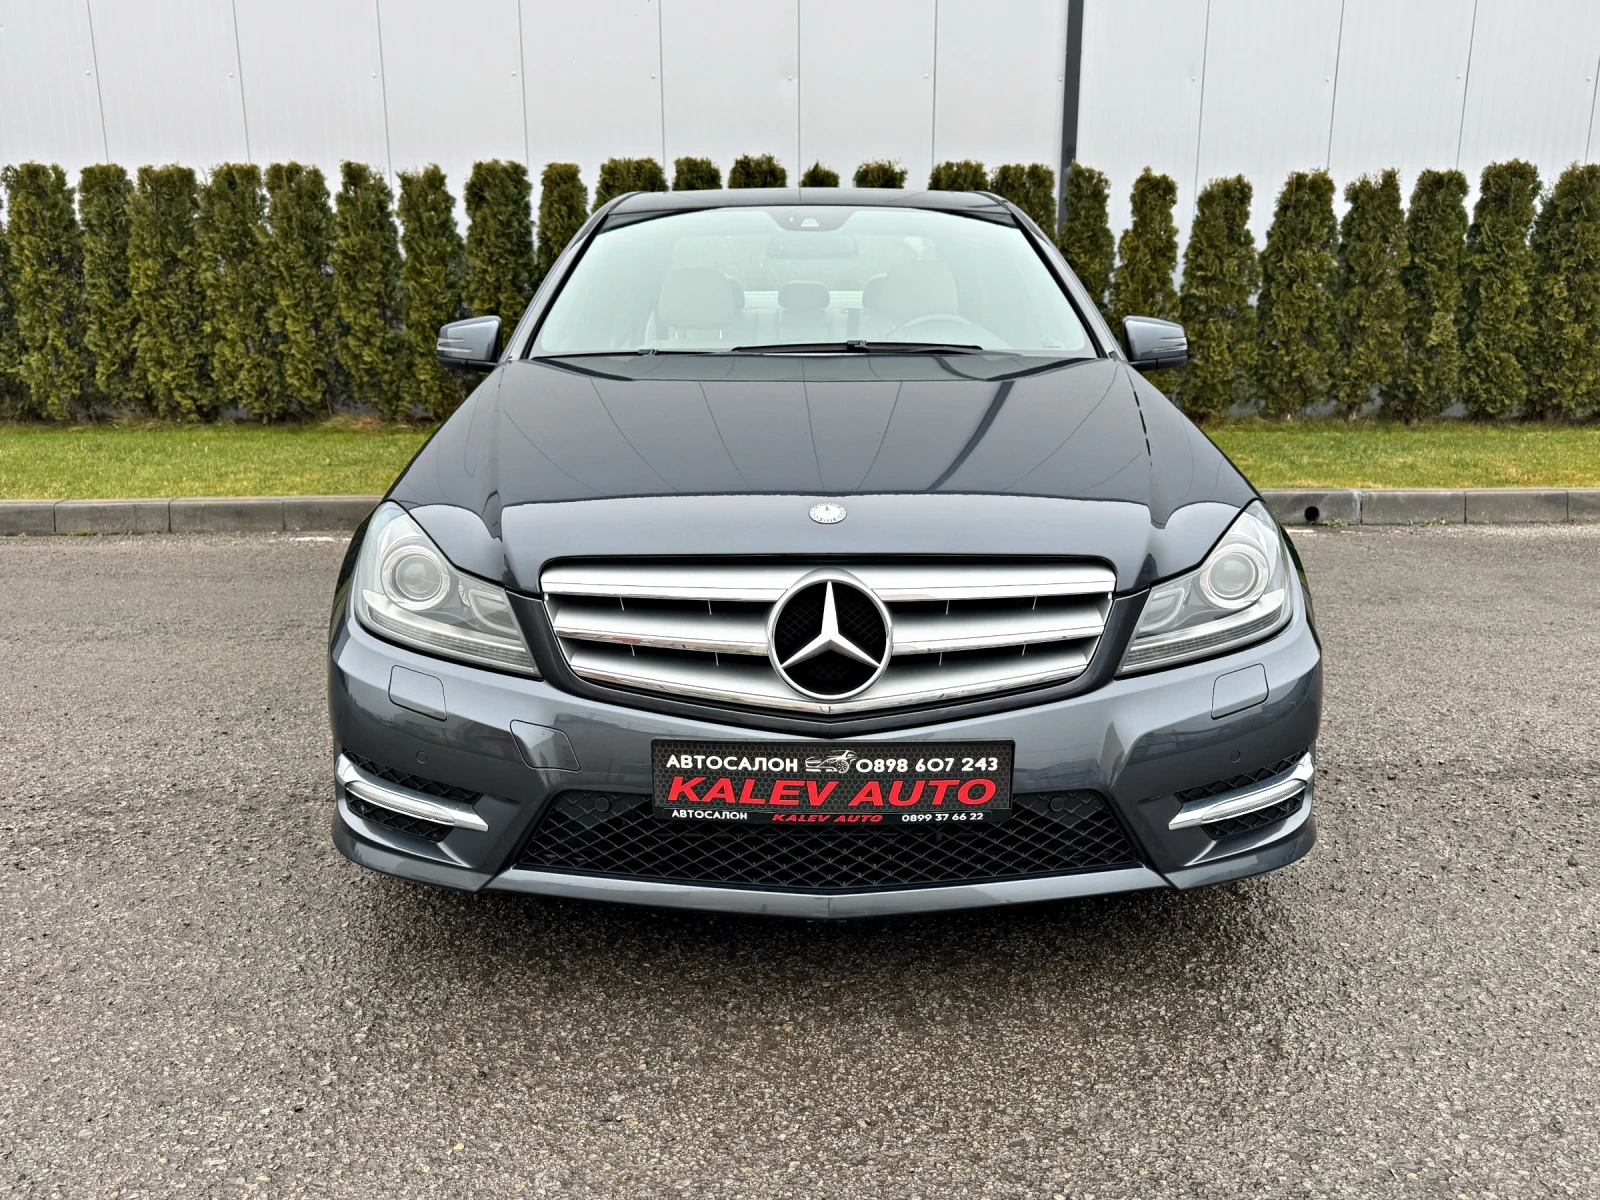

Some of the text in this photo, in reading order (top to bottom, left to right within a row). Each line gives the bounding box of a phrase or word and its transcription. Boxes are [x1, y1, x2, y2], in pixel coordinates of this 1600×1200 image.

[666, 754, 798, 772] АВТОСАЛОН
[961, 757, 998, 772] 243
[667, 776, 997, 806] KALEV AUTO
[671, 809, 748, 820] АВТОСАЛОН
[772, 813, 883, 822] KALEV AUTO
[901, 812, 983, 822] 0899 37 66 22
